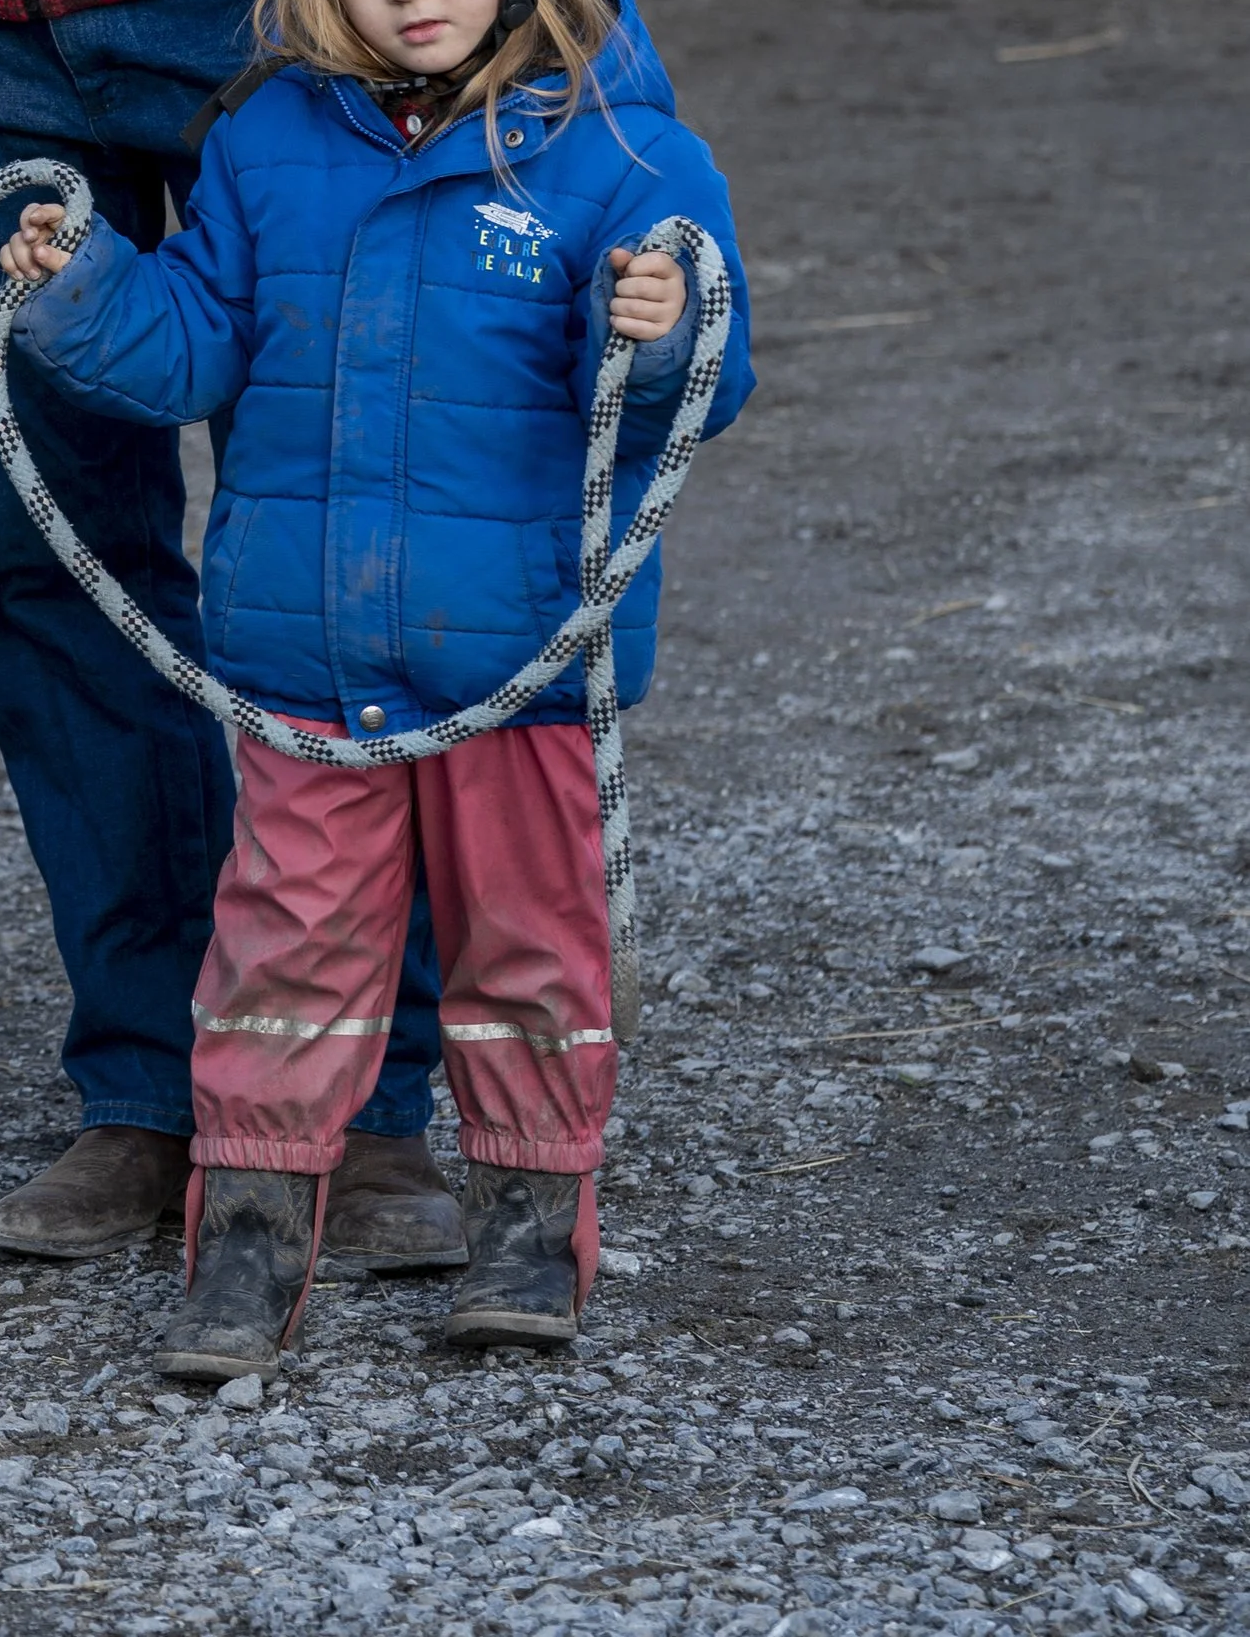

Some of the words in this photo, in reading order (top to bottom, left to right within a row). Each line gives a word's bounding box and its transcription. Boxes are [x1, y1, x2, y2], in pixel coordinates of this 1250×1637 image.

[479, 230, 541, 257] EXPLORE
[471, 250, 495, 271] THE
[499, 261, 549, 284] GALAXY
